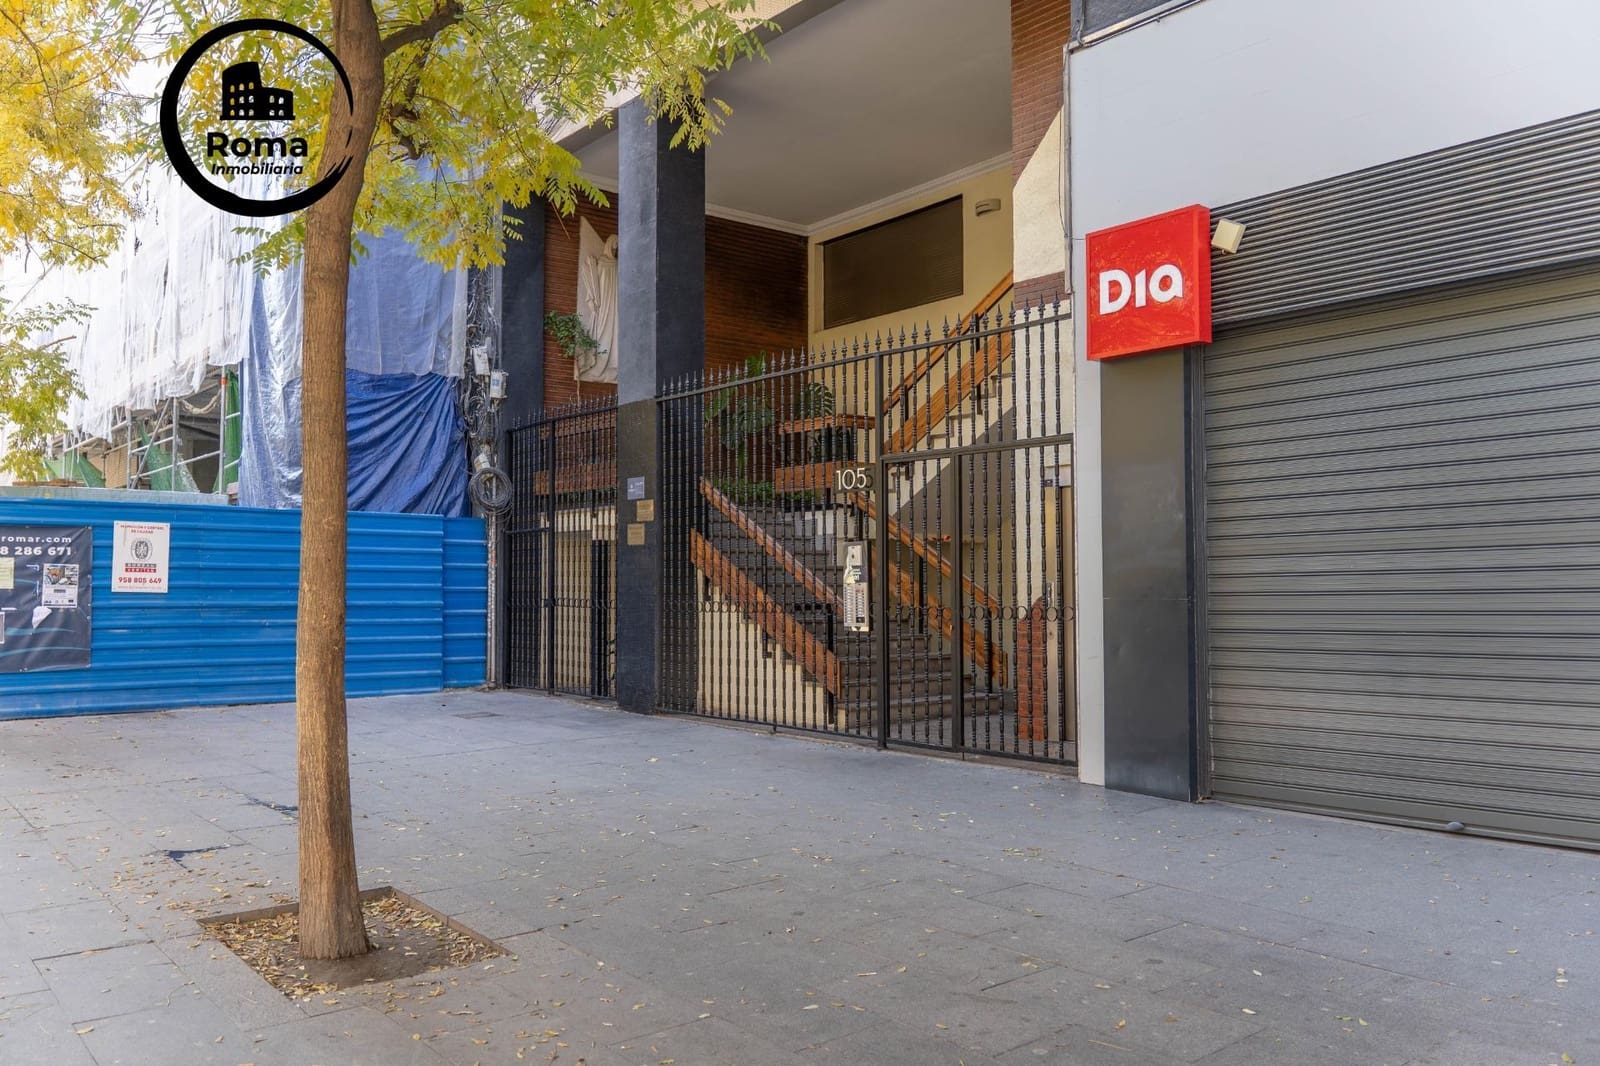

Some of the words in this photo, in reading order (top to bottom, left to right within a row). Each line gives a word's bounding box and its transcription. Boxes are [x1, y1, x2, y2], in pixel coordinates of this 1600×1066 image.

[836, 467, 867, 490] 105
[14, 546, 42, 556] 286
[47, 546, 72, 556] 671
